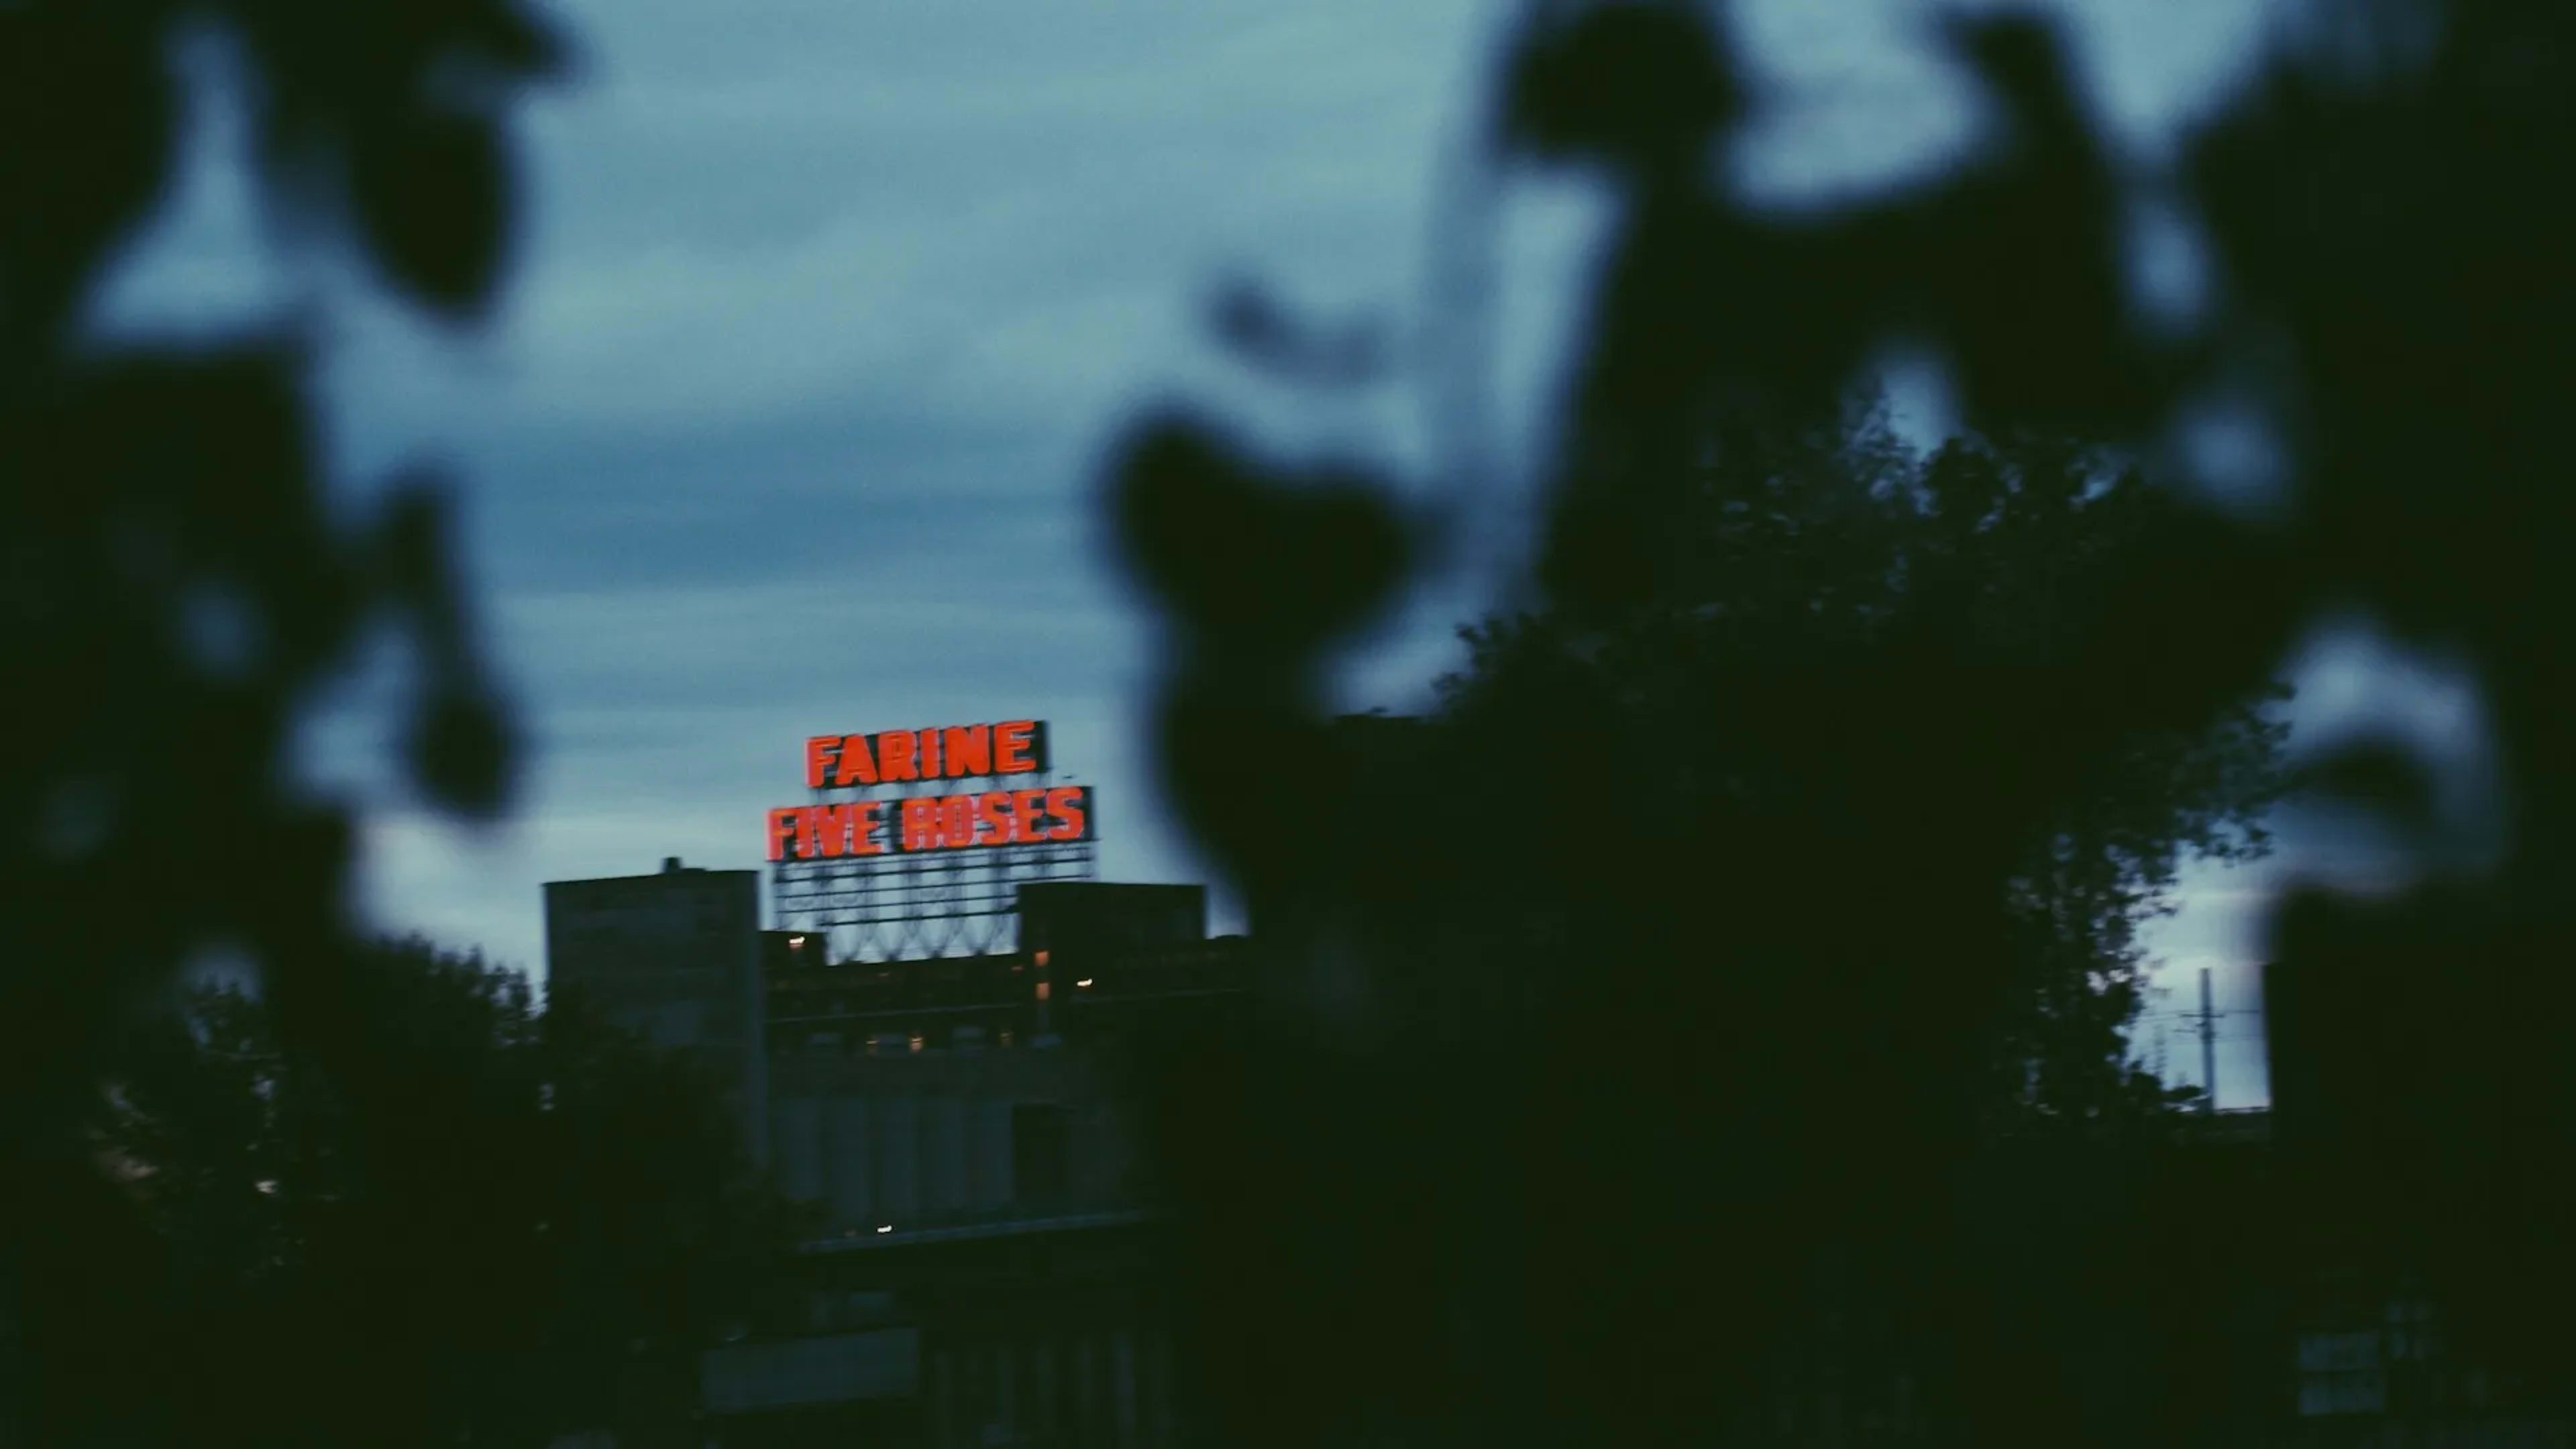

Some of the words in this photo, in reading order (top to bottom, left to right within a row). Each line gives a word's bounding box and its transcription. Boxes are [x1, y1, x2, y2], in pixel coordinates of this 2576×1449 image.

[806, 720, 1036, 788] FARINE
[767, 802, 883, 861] FIVE
[901, 786, 1085, 851] ROSES
